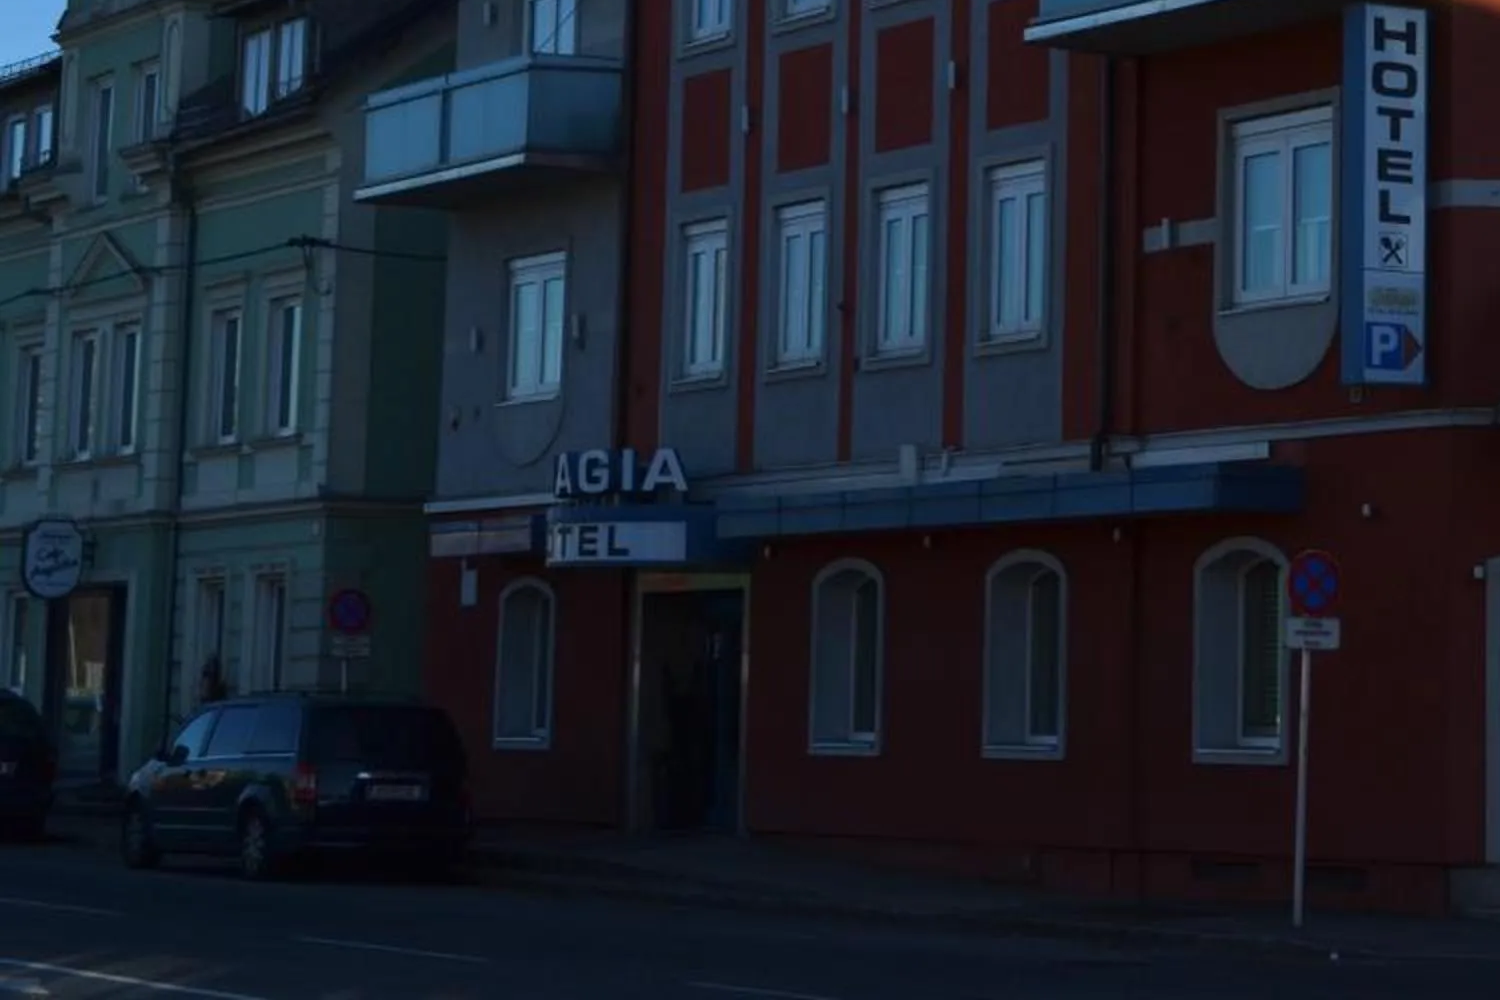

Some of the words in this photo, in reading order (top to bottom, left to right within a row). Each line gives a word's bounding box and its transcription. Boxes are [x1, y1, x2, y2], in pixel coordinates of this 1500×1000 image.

[1371, 16, 1419, 226] HOTEL
[1370, 324, 1399, 367] P
[553, 447, 689, 496] AGIA
